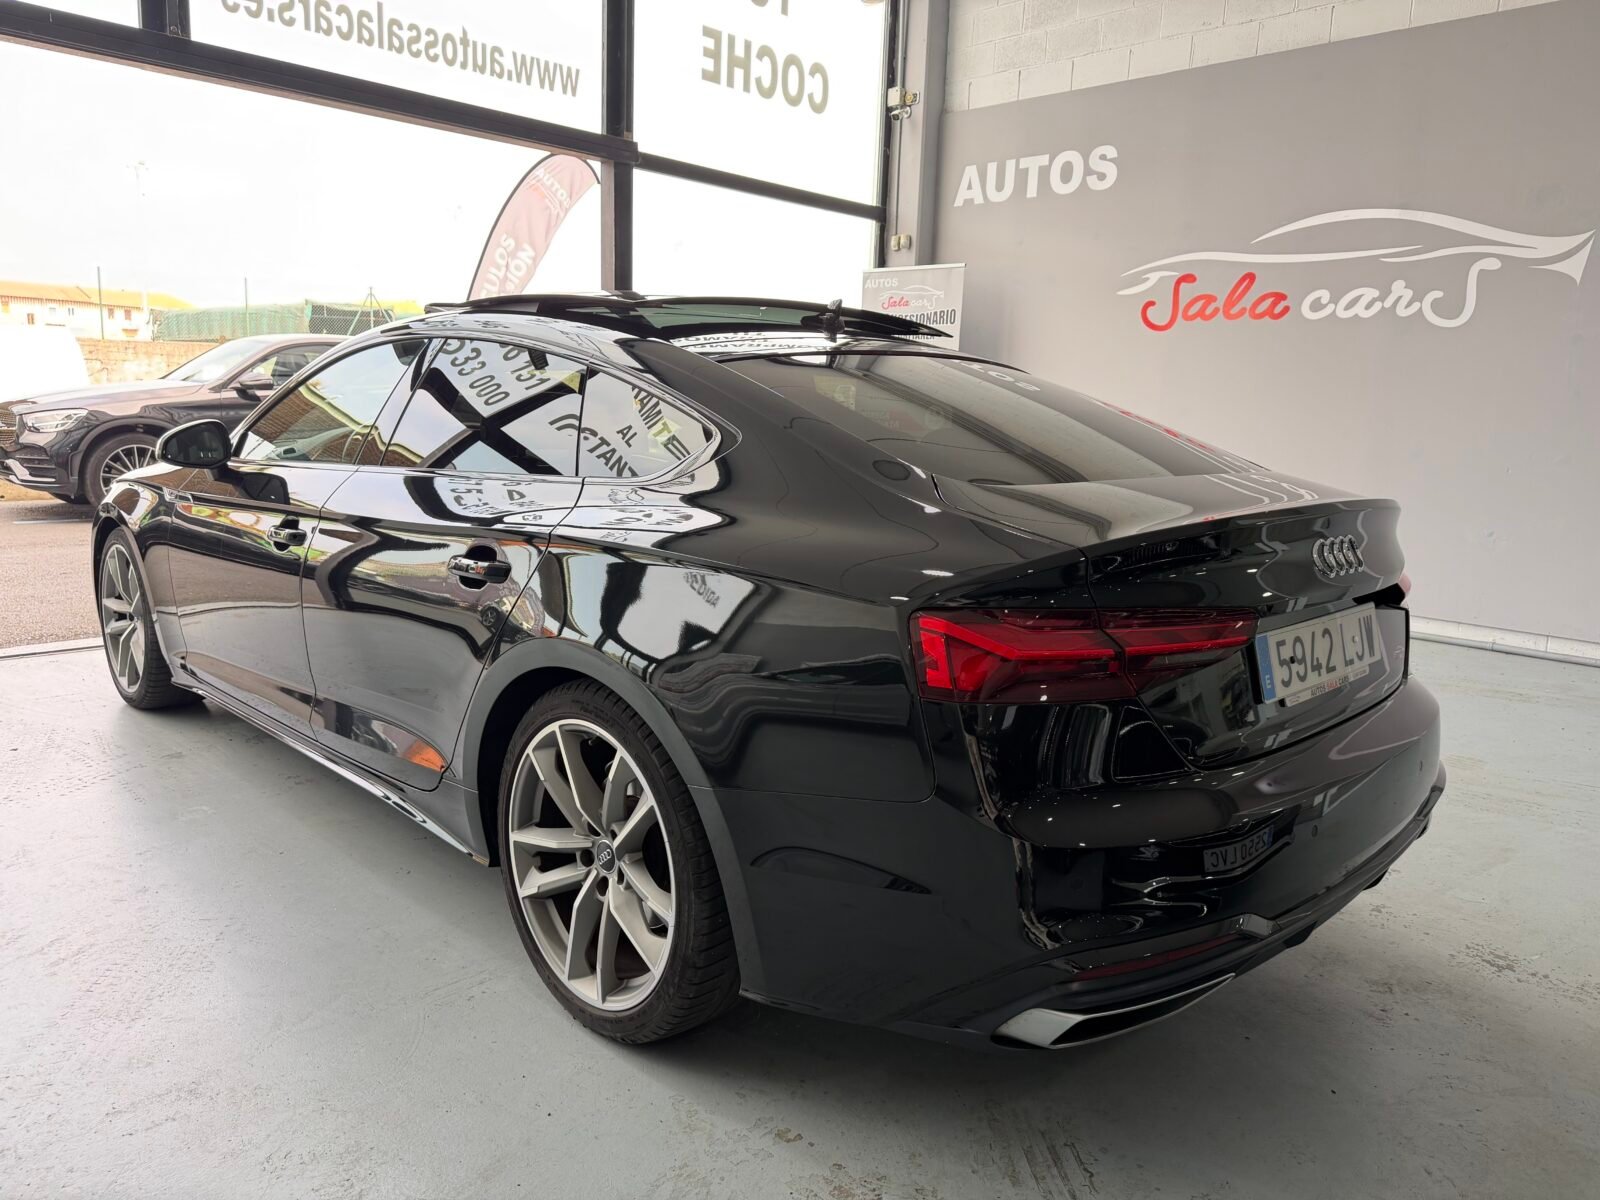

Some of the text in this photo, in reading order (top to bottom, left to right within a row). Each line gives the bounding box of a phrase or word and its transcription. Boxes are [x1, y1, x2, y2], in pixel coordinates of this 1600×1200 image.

[954, 145, 1118, 206] AUTOS
[864, 278, 899, 289] AUTOS
[1141, 272, 1290, 332] Sala
[616, 425, 639, 448] AL
[1275, 614, 1376, 688] 5942 LJW
[1265, 675, 1272, 689] E
